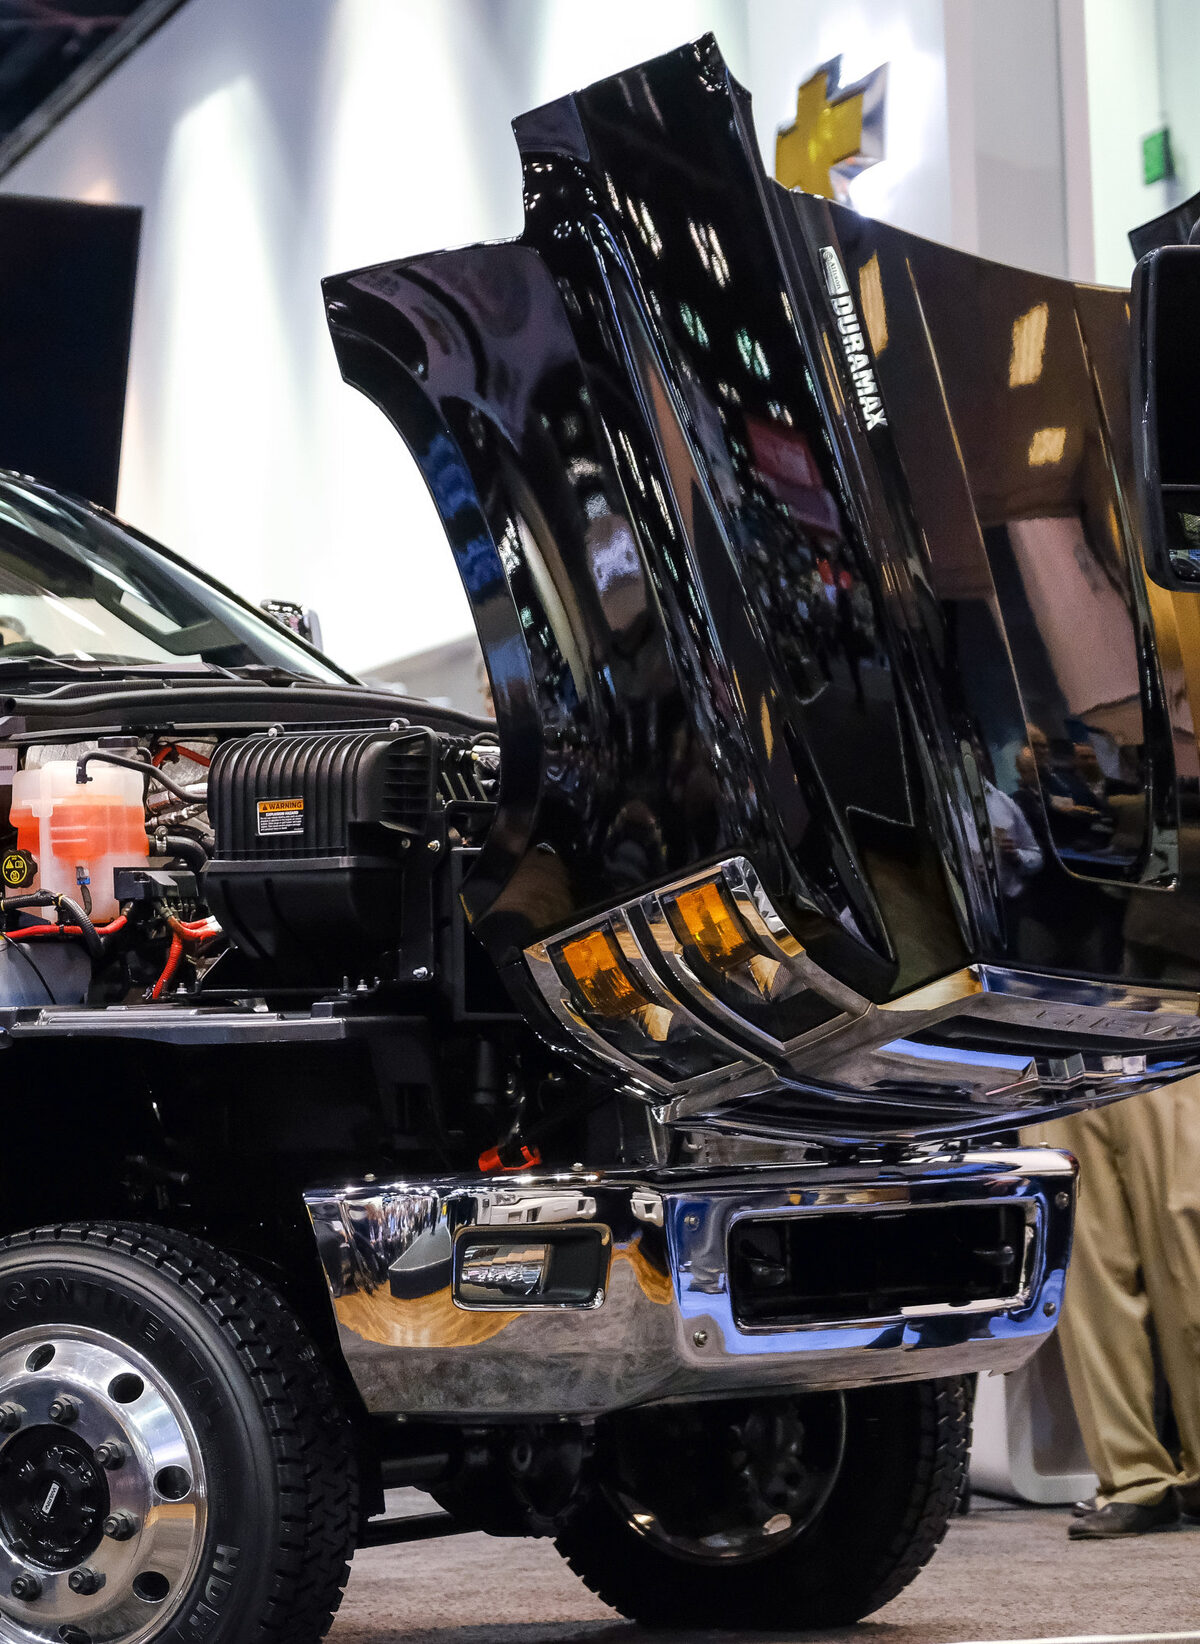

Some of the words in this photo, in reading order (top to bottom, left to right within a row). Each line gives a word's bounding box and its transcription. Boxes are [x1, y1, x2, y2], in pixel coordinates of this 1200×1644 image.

[830, 294, 888, 431] DURAMAX
[269, 801, 302, 811] WARNING
[5, 1274, 223, 1424] CONTINENTAL
